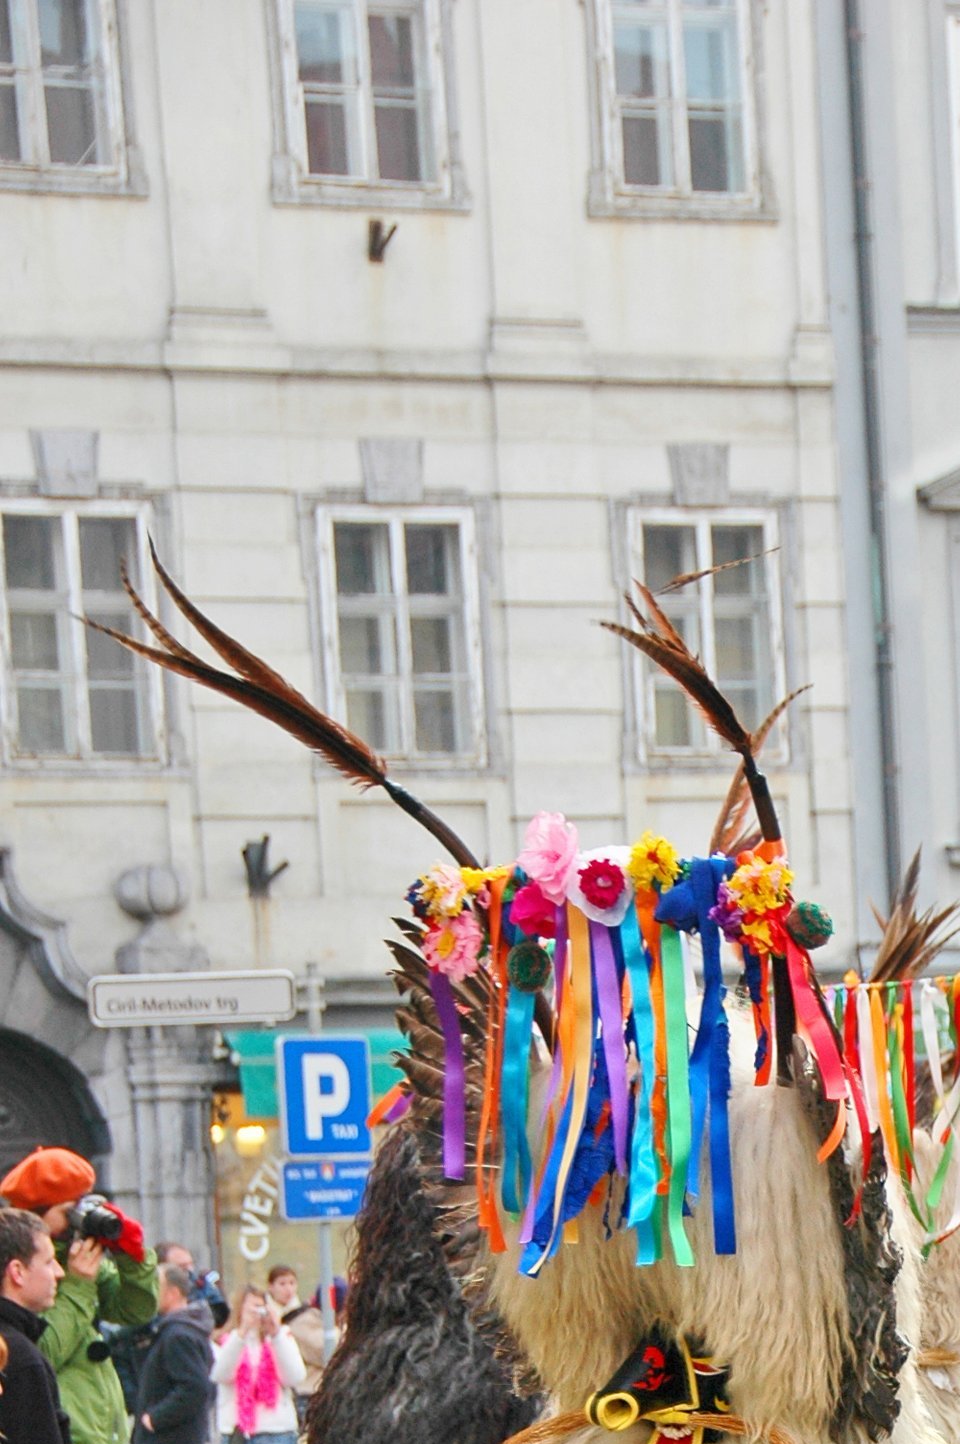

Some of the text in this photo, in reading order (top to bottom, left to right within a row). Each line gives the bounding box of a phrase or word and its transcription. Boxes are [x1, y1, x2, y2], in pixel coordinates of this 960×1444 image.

[106, 995, 239, 1013] Ciril-Metodov trg
[302, 1053, 351, 1140] P
[331, 1123, 359, 1139] TAXI
